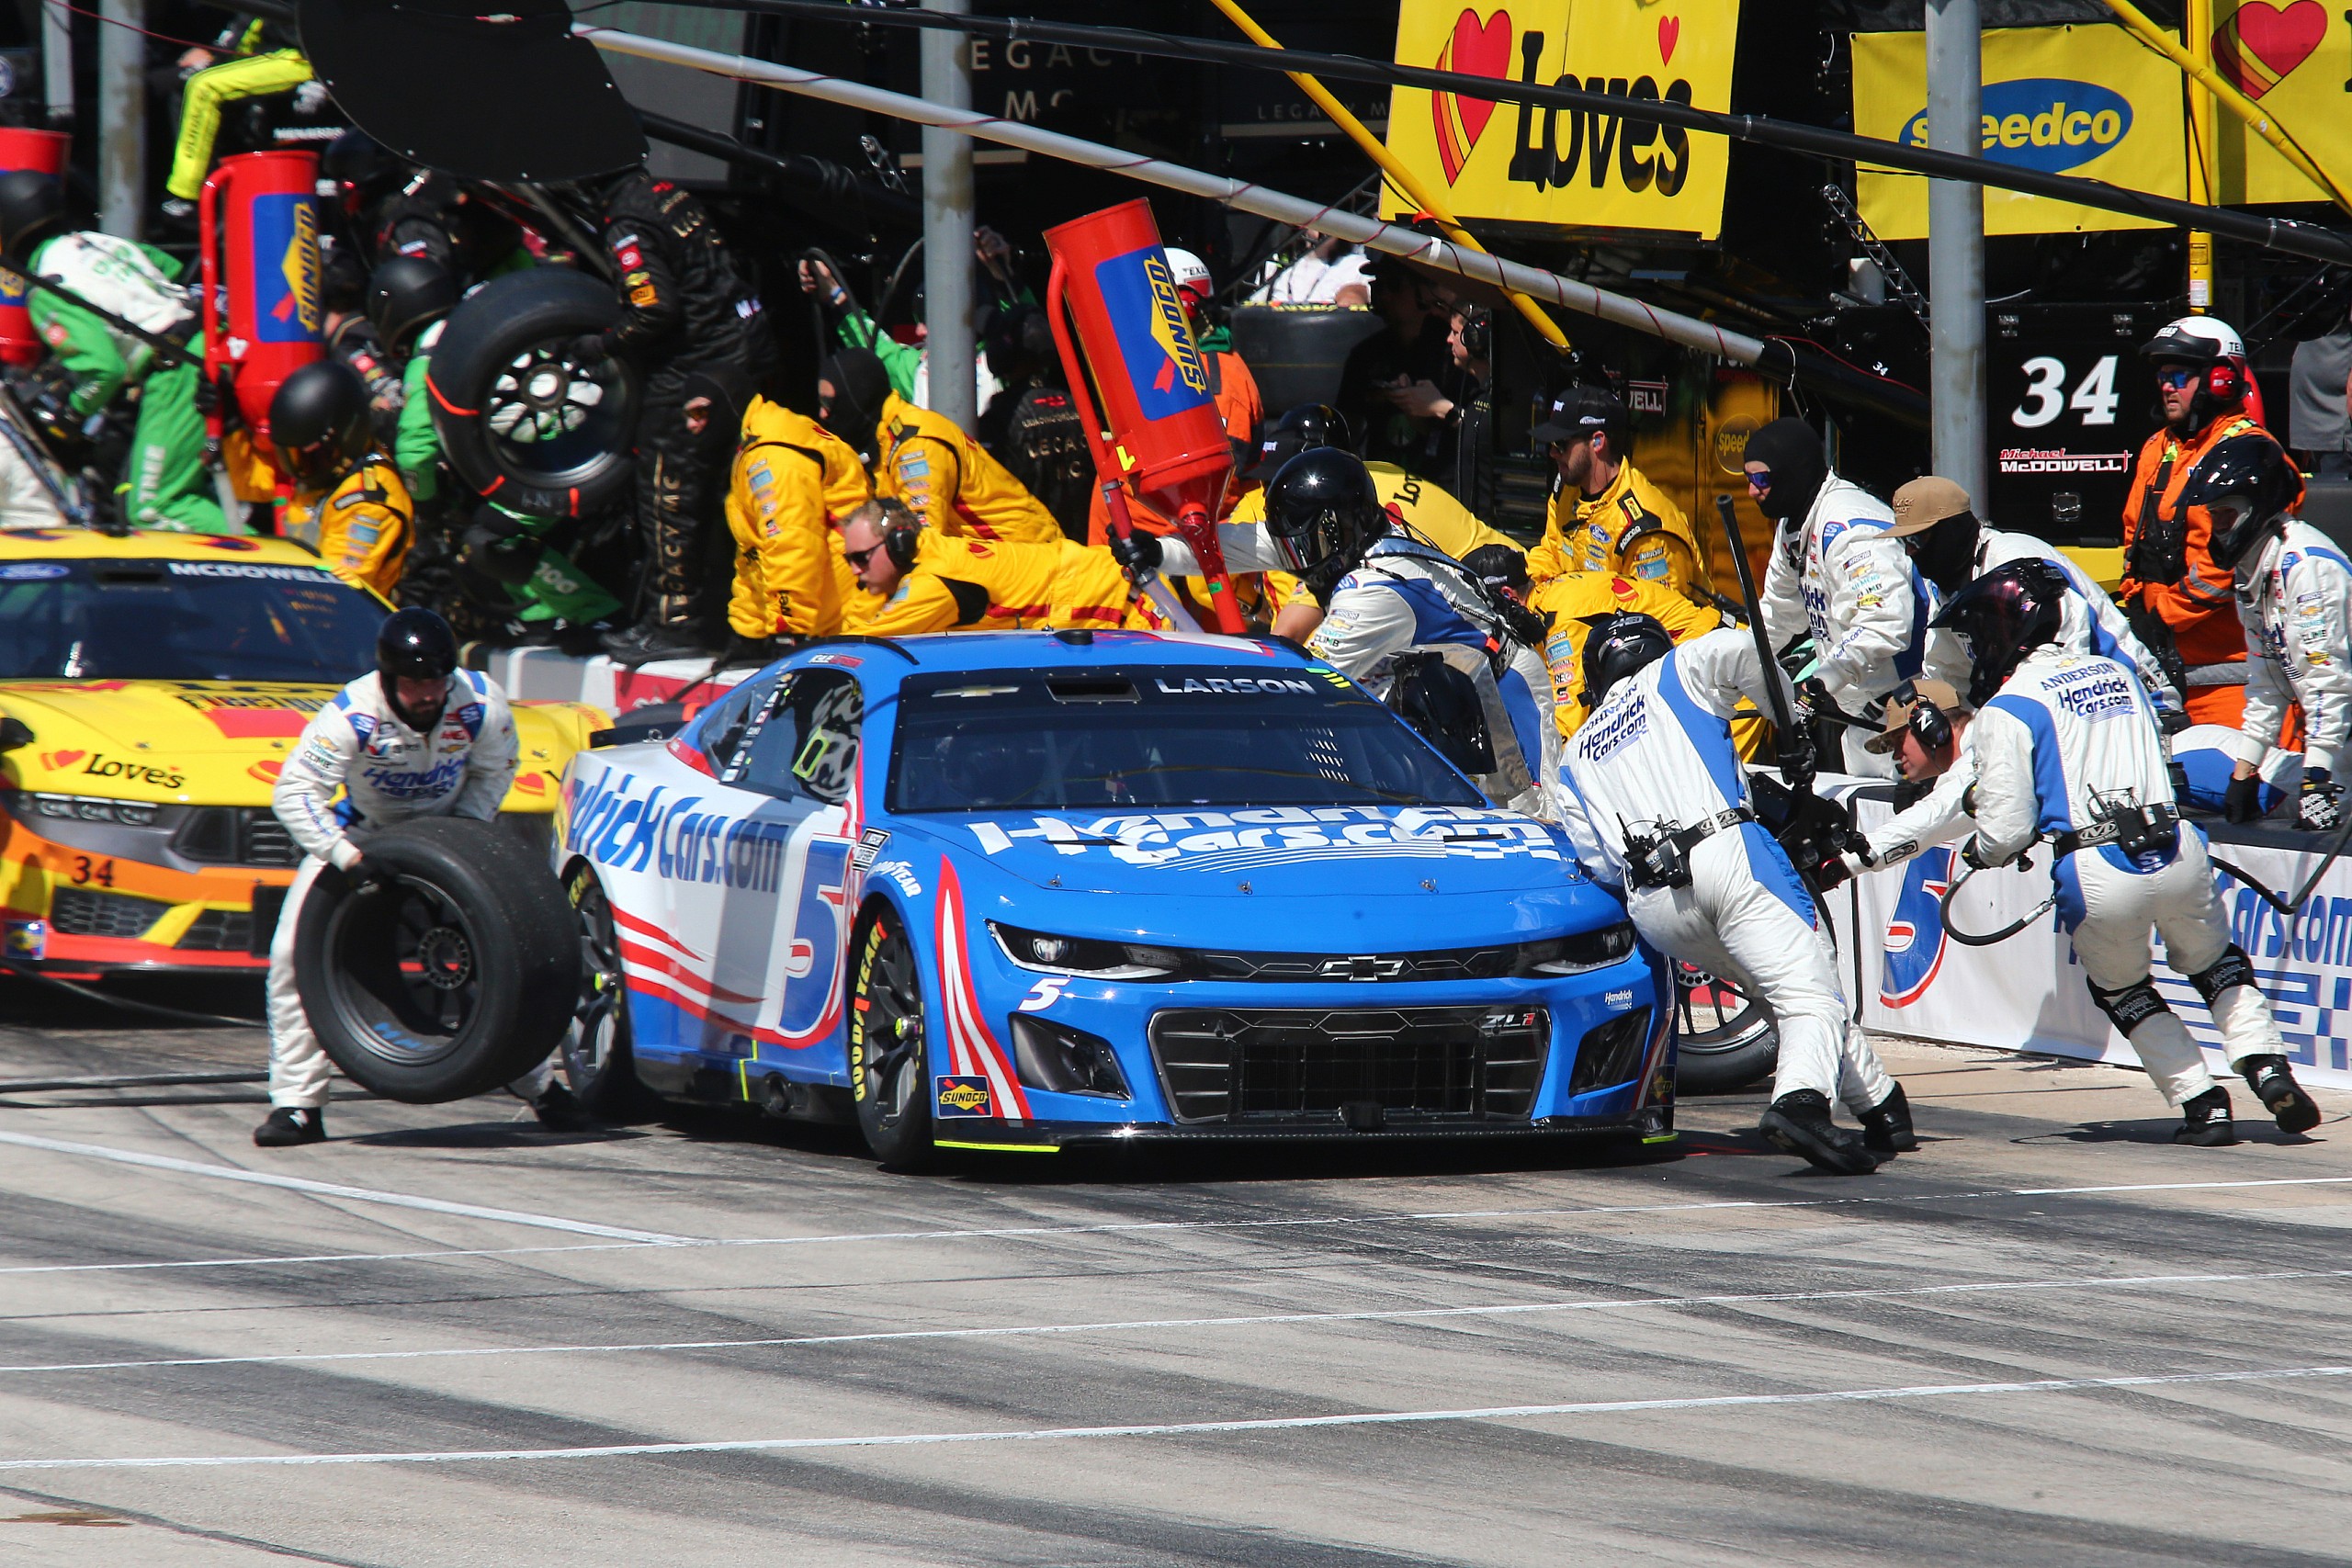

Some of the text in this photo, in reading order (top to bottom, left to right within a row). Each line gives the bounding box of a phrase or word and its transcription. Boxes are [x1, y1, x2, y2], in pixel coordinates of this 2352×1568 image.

[970, 39, 1144, 70] EGAC
[1257, 102, 1355, 120] LEGAY
[1910, 102, 2120, 150] seedco
[1148, 264, 1204, 388] SUNOCO
[1872, 361, 1889, 377] 34
[2011, 355, 2120, 429] 34
[2000, 447, 2066, 460] Michael
[1848, 550, 1871, 566] NASCAR
[1154, 678, 1317, 695] LARSON
[2040, 662, 2120, 691] ANDERSON
[2058, 676, 2130, 713] Hendrick
[2076, 694, 2132, 717] Cars.com
[1578, 694, 1645, 760] Hendrick
[1592, 713, 1646, 762] Cars.com
[72, 855, 115, 887] 34
[777, 832, 856, 1040] 5
[1880, 840, 1956, 1009] 5
[1017, 976, 1073, 1012] 5
[1605, 989, 1633, 1006] Hendrick
[1480, 1012, 1536, 1030] ZL1
[943, 1091, 987, 1103] SUNOCO
